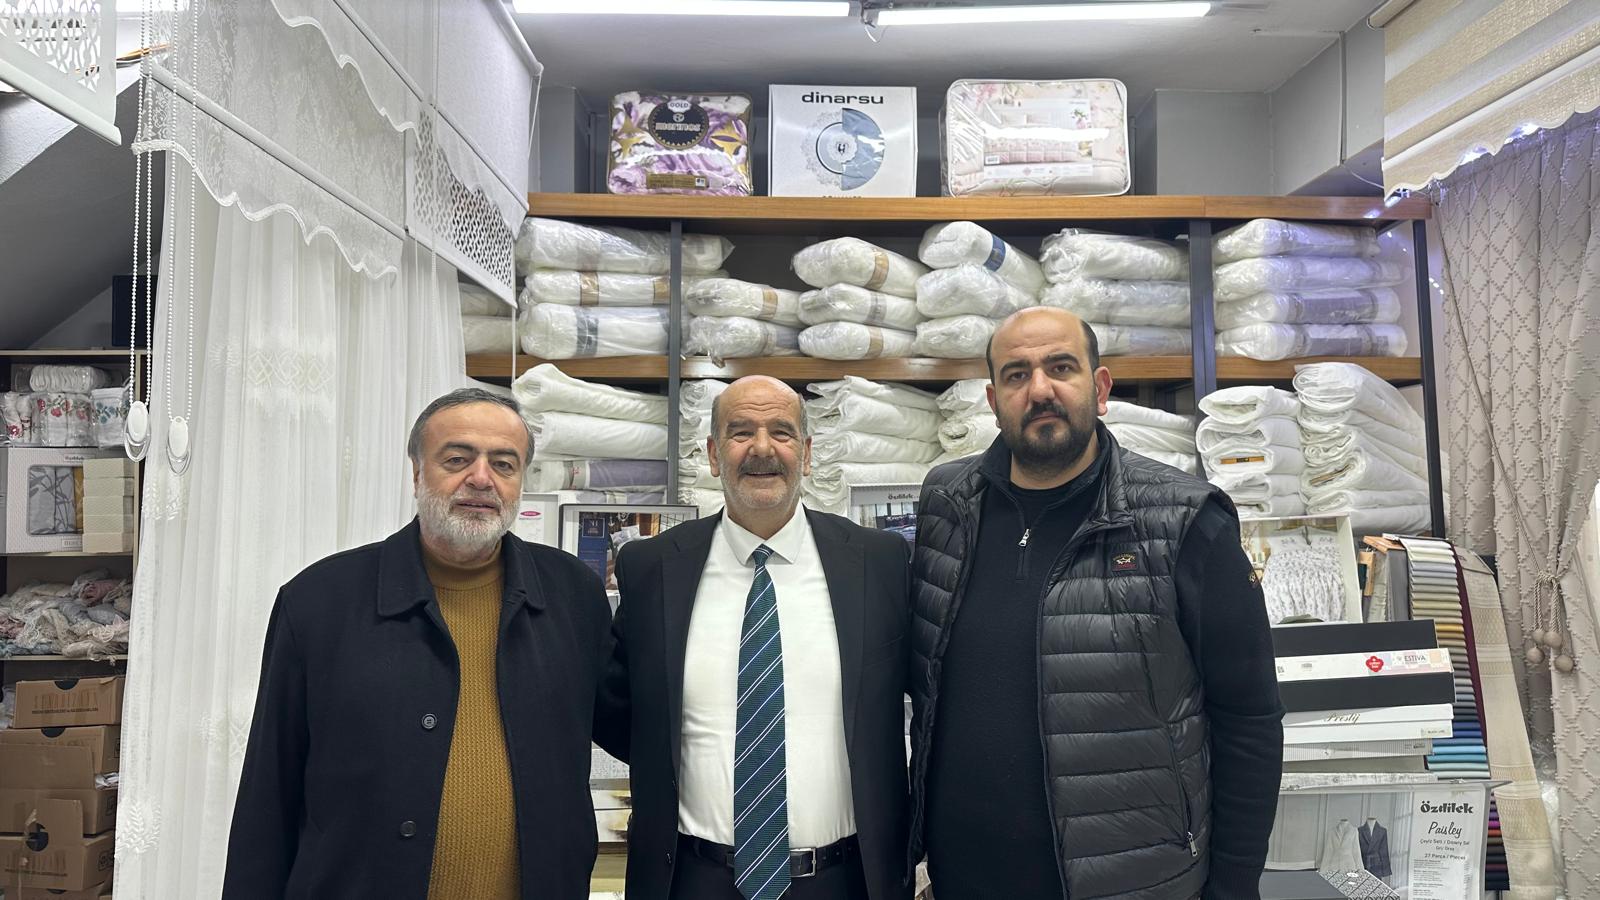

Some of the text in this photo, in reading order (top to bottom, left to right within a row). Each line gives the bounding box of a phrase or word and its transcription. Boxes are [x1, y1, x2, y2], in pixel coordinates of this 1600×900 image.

[801, 91, 884, 104] dinarsu
[1420, 800, 1474, 813] Özdilek
[1428, 821, 1462, 839] Paisley
